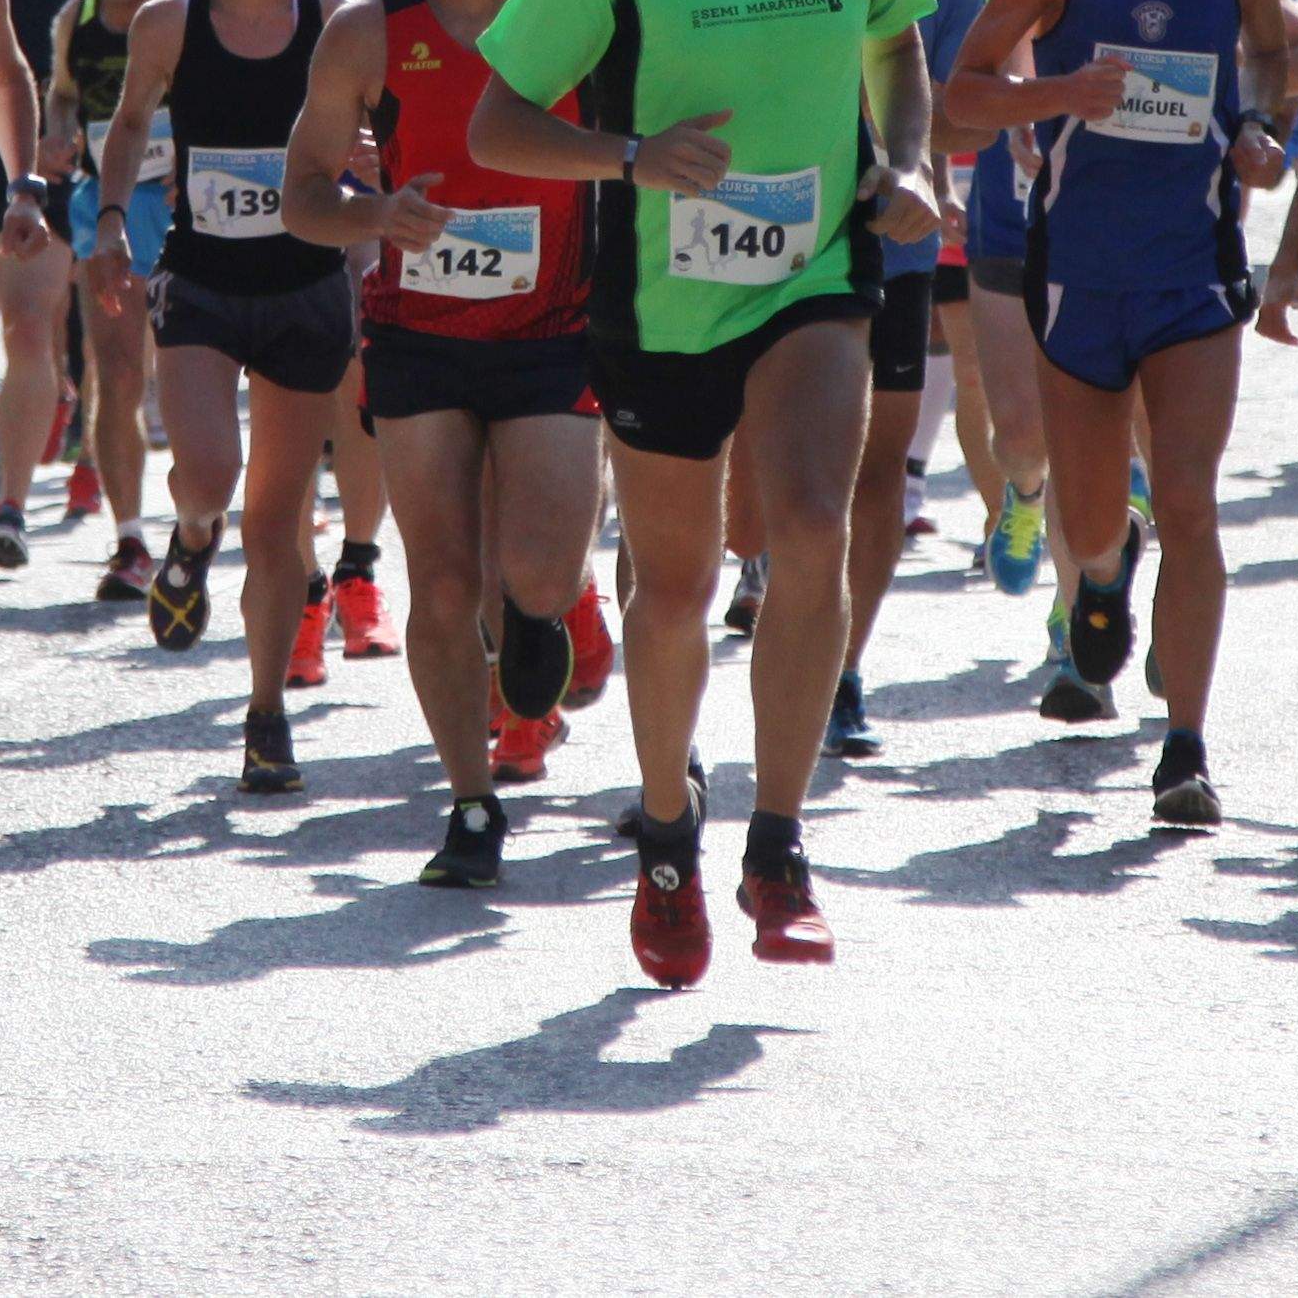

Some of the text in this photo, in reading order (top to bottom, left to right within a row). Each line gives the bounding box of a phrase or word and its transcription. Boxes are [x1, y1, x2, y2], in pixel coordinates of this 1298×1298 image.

[701, 5, 740, 20] SEMI
[1151, 81, 1161, 93] 8
[1117, 98, 1188, 117] MIGUEL
[716, 181, 759, 194] CURSA
[220, 188, 281, 218] 139
[711, 223, 786, 259] 140
[436, 248, 502, 278] 142
